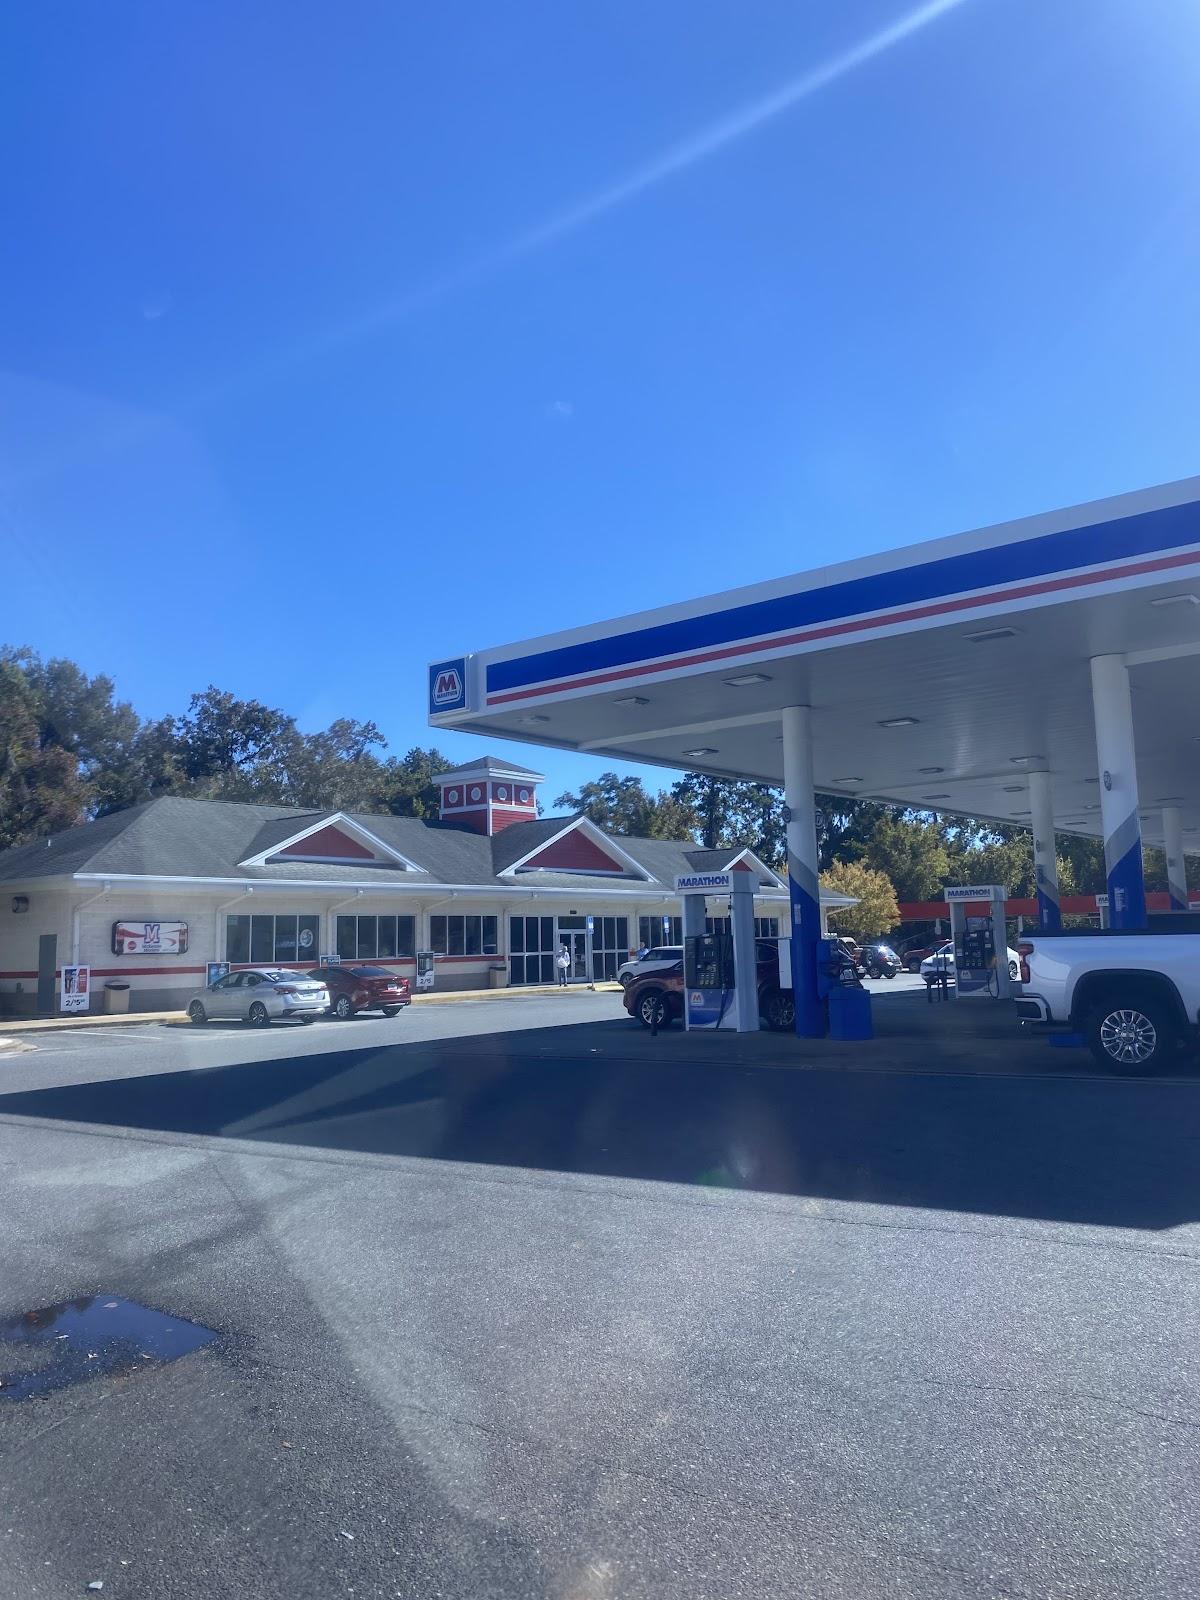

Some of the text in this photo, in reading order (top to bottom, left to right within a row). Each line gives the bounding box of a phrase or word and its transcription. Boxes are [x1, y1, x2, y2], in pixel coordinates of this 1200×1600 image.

[438, 674, 457, 692] M
[437, 691, 458, 699] MARATHON
[678, 875, 729, 887] MARATHON
[947, 888, 990, 897] MARATHON
[144, 924, 160, 944] M
